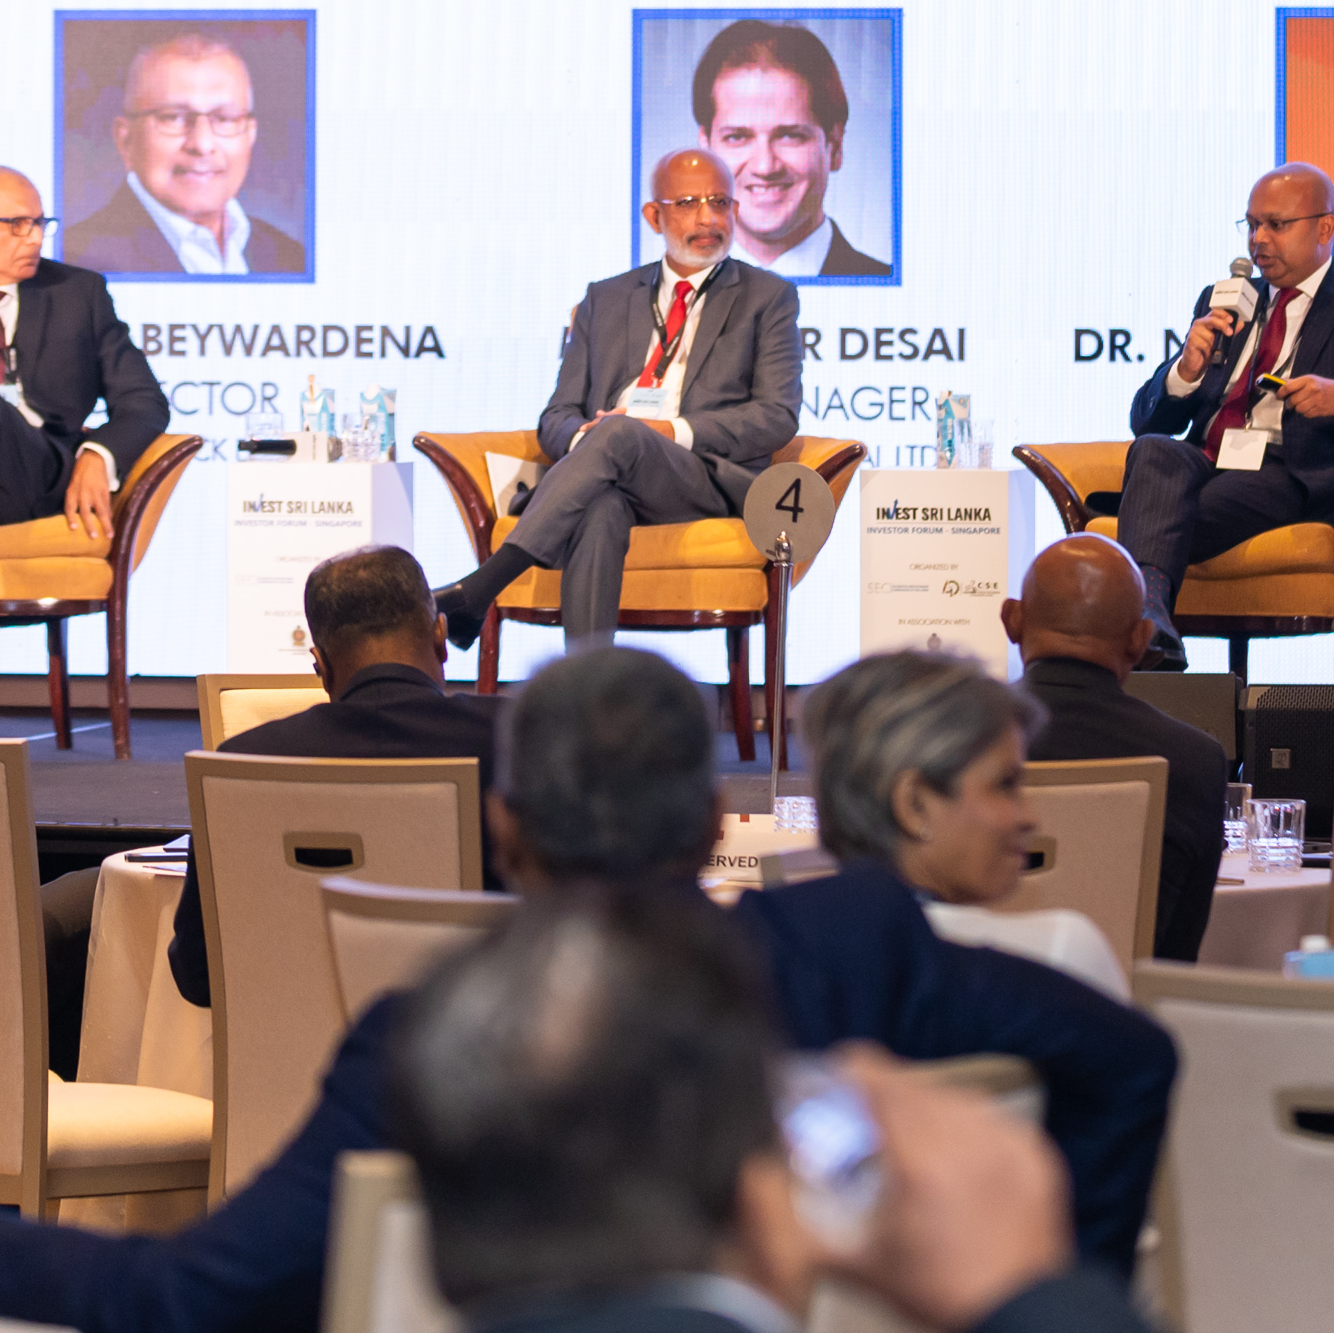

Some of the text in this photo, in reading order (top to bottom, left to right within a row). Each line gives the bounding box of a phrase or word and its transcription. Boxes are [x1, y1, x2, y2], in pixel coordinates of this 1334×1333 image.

[141, 323, 446, 358] BEYWARDENA
[838, 327, 966, 361] DESAI
[1074, 328, 1145, 362] DR.
[159, 381, 280, 416] CTOR
[802, 386, 932, 421] NAGER
[243, 496, 354, 515] INVEST SRI LANKA
[775, 478, 804, 523] 4
[876, 503, 992, 522] INVEST SRI LANKA
[234, 519, 275, 527] INVESTOR
[315, 519, 363, 528] SINGAPORE
[867, 526, 910, 534] INVESTOR
[951, 527, 1002, 535] SINGAPORE
[909, 563, 948, 571] ORGANIZED
[707, 854, 759, 868] ERVED
